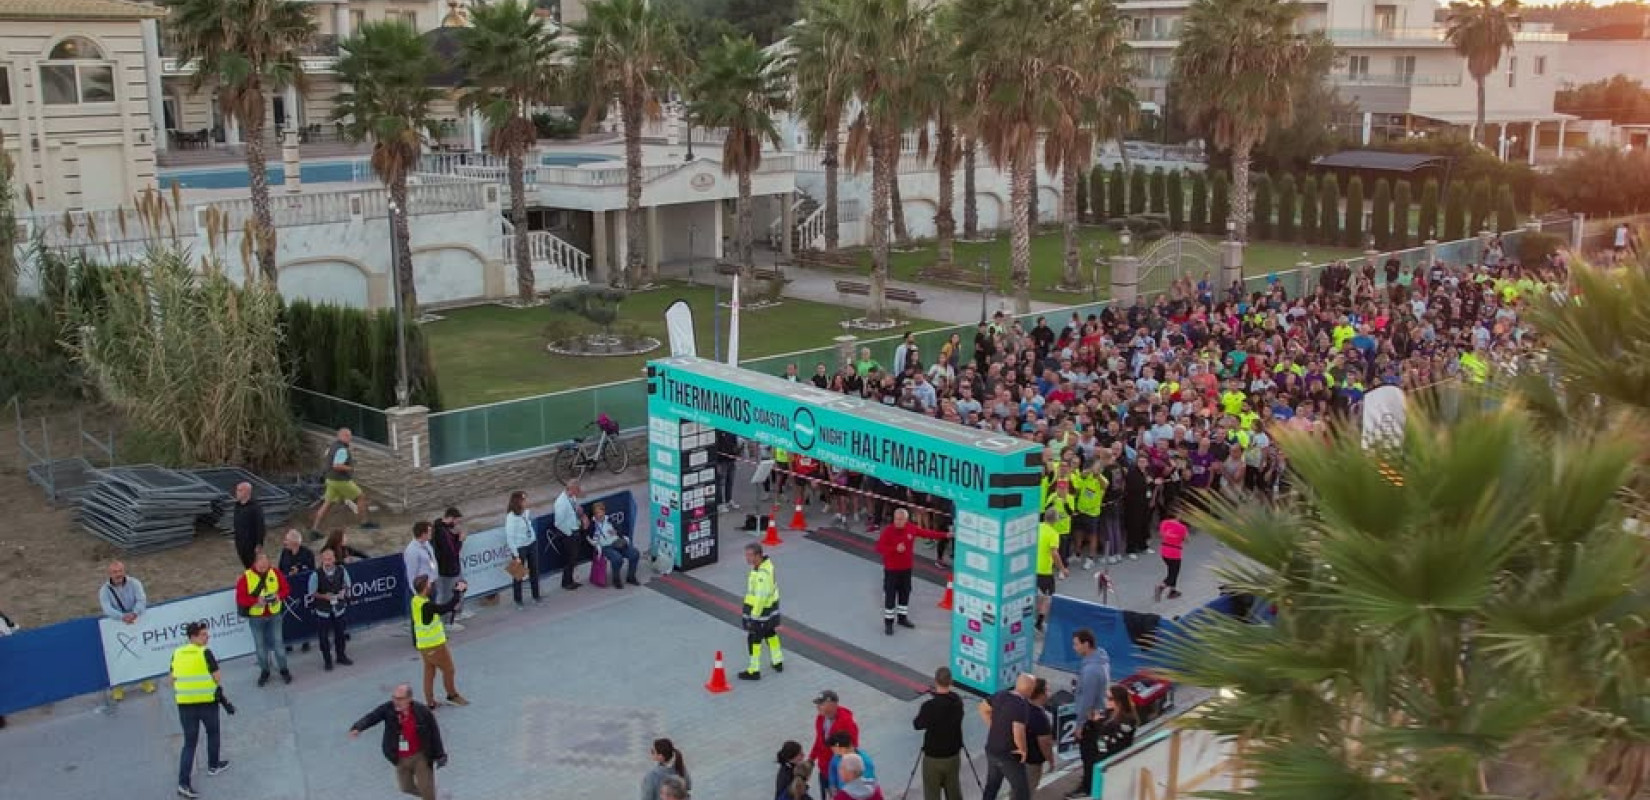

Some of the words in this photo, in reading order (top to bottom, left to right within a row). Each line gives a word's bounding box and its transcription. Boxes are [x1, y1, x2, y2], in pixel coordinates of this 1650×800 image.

[667, 379, 751, 424] THERMAIKOS
[753, 405, 790, 431] COASTAL
[819, 425, 848, 448] NIGHT
[851, 430, 986, 492] HALFMARATHON
[303, 576, 396, 608] PIOMED
